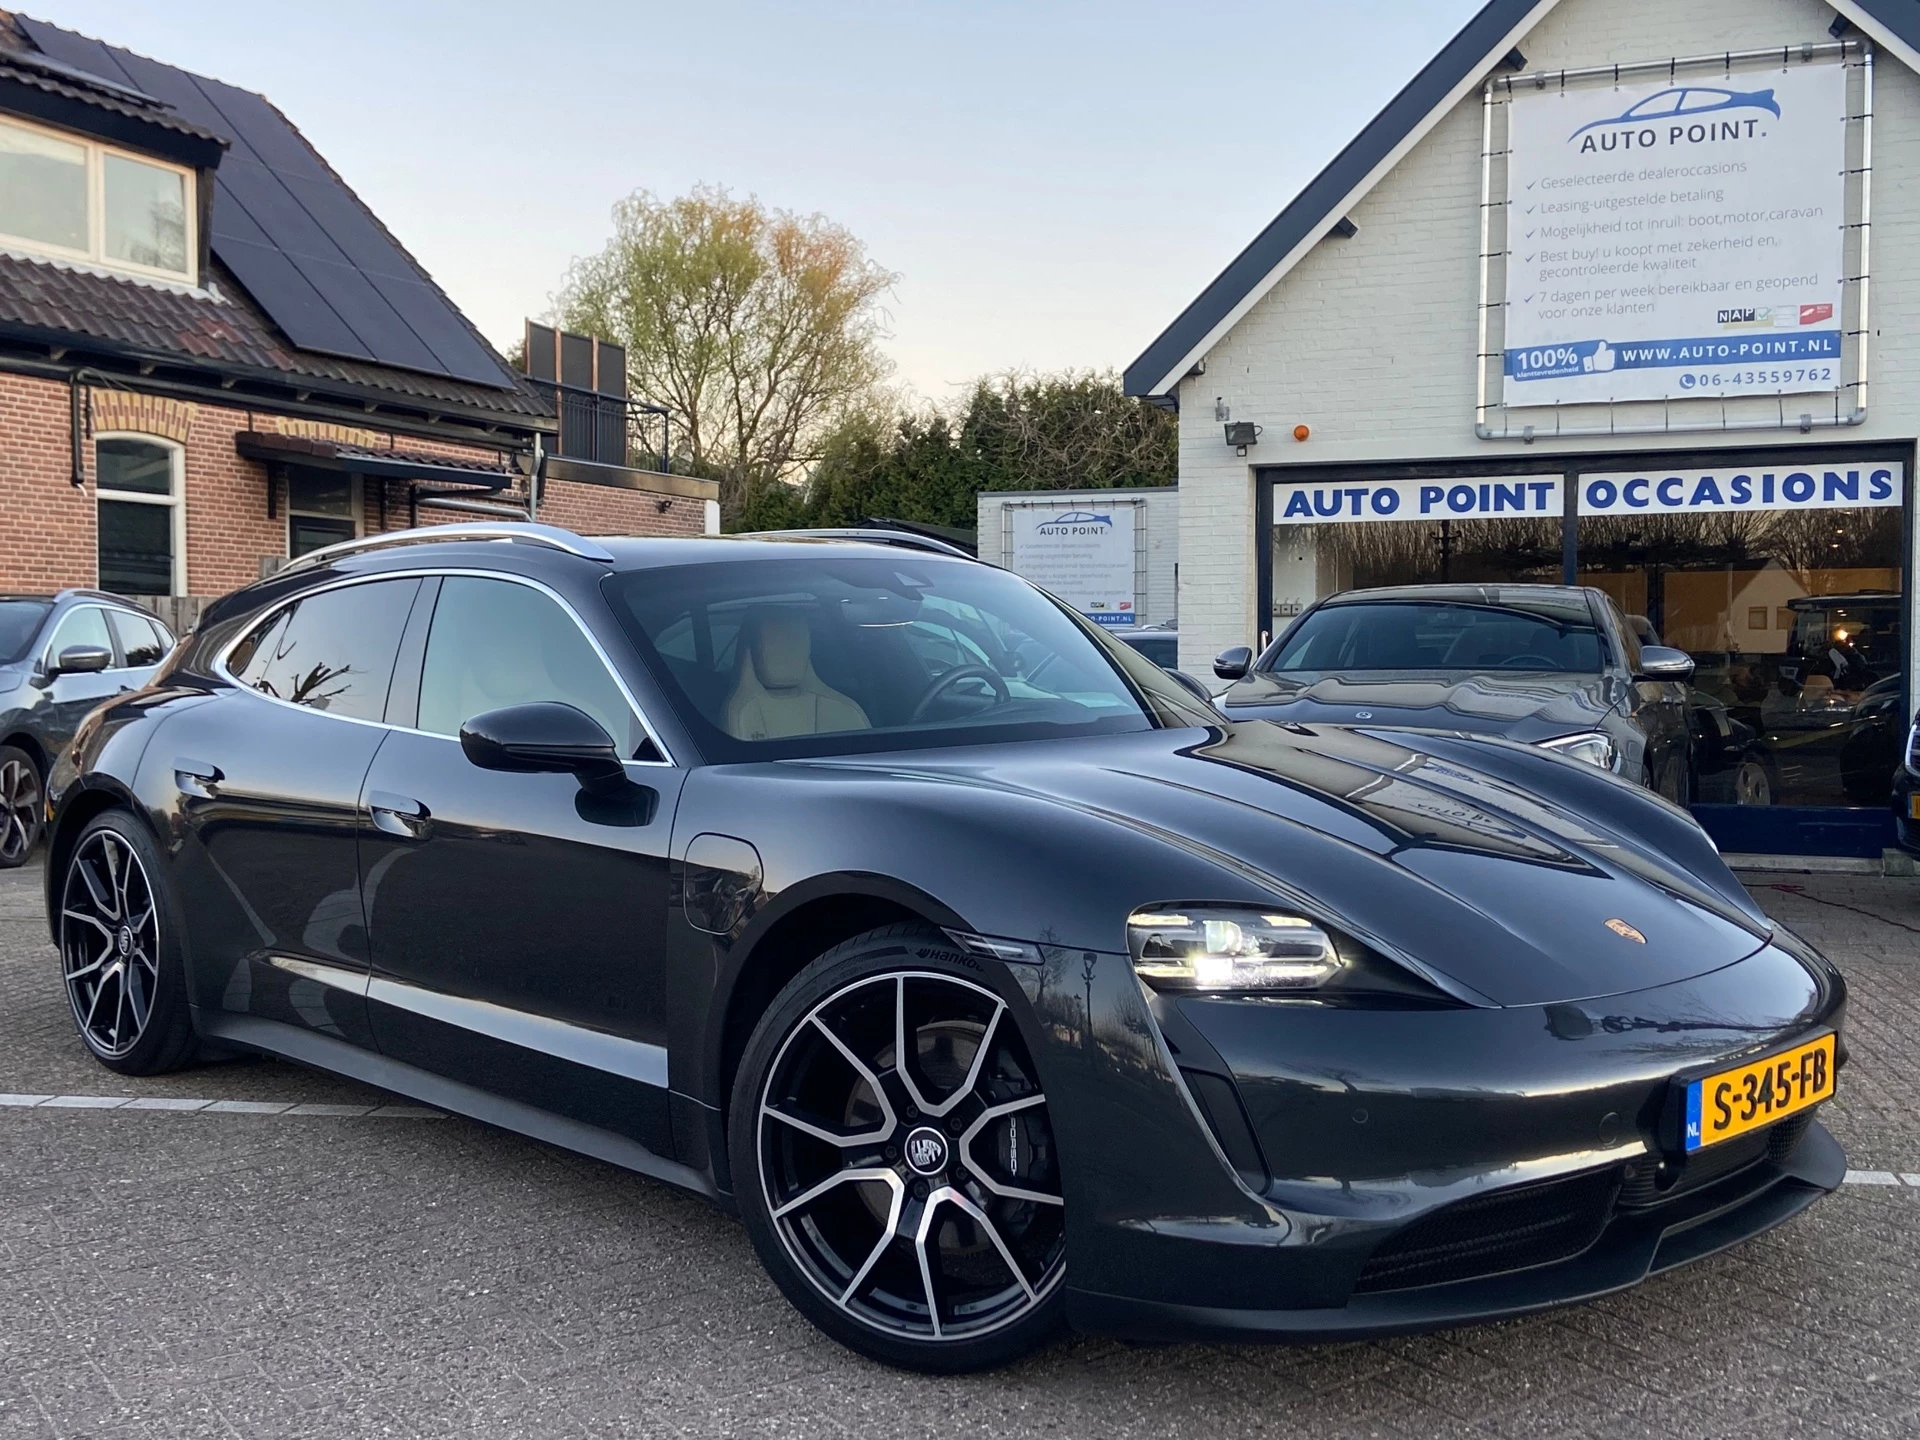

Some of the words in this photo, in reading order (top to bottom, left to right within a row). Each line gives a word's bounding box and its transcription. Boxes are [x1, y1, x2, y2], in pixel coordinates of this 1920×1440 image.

[1580, 129, 1656, 154] AUTO
[1541, 170, 1635, 190] Geselecteerde
[1638, 161, 1747, 181] dealeroccasions
[1540, 193, 1666, 214] Leasing-uitgestelde
[1670, 187, 1724, 203] betaling
[1540, 220, 1621, 240] Mogelijkheid
[1625, 220, 1644, 232] tot
[1647, 216, 1685, 229] inruil:
[1688, 206, 1823, 226] boot,motor,caravan
[1540, 250, 1568, 263] Best
[1571, 247, 1599, 262] buy!
[1602, 248, 1611, 258] u
[1615, 245, 1652, 258] koopt
[1657, 242, 1683, 254] met
[1687, 235, 1753, 252] zekerheid
[1539, 261, 1639, 282] gecontroleerde
[1643, 256, 1697, 271] kwaliteit
[1539, 291, 1547, 303] 7
[1550, 290, 1591, 305] dagen
[1594, 287, 1617, 301] per
[1620, 283, 1655, 298] week
[1658, 280, 1730, 296] bereikbaar
[1735, 280, 1752, 290] en
[1755, 273, 1818, 293] geopend
[1538, 308, 1567, 319] voor
[1571, 306, 1603, 318] onze
[1606, 302, 1655, 315] klanten
[1718, 308, 1755, 323] NAP
[1517, 347, 1578, 370] 100%
[1622, 339, 1832, 362] WWW.AUTO-POINT.NL
[1516, 365, 1579, 378] klanttevredenheid
[1699, 368, 1831, 387] 06-43559762
[1283, 487, 1400, 518] AUTO
[1420, 482, 1555, 514] POINT
[1586, 469, 1893, 509] OCCASIONS
[1040, 527, 1068, 536] AUTO
[1713, 1048, 1827, 1131] S-345-FB
[1687, 1121, 1700, 1139] NL
